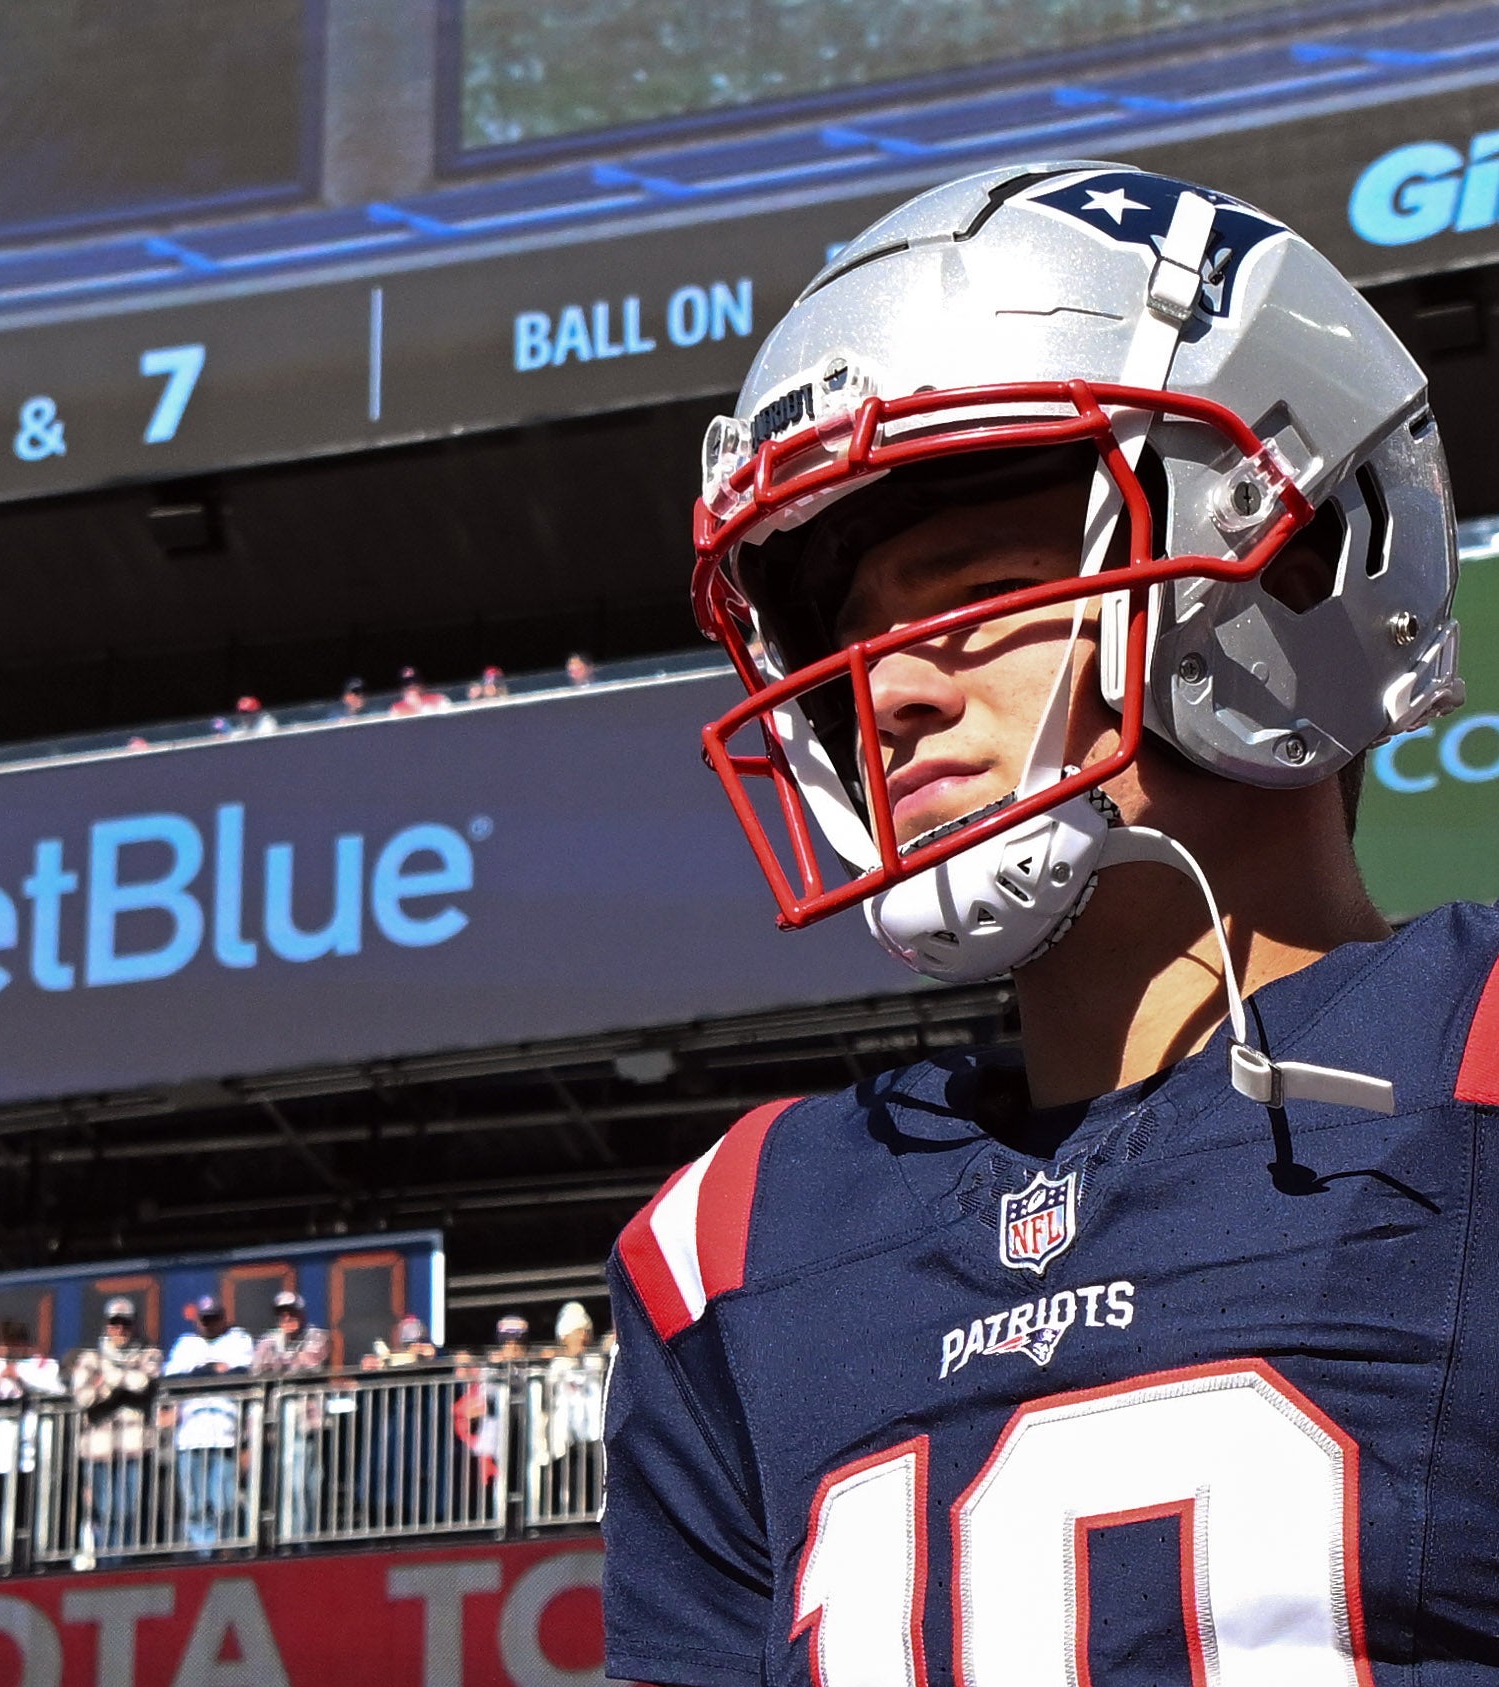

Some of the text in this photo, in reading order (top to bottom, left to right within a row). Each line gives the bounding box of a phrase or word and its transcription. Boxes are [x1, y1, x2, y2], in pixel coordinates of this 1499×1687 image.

[514, 277, 753, 372] BALL ON
[14, 395, 67, 461] &
[140, 343, 207, 444] 7
[1009, 1210, 1062, 1256] NFL
[938, 1280, 1136, 1380] PATRIOTS
